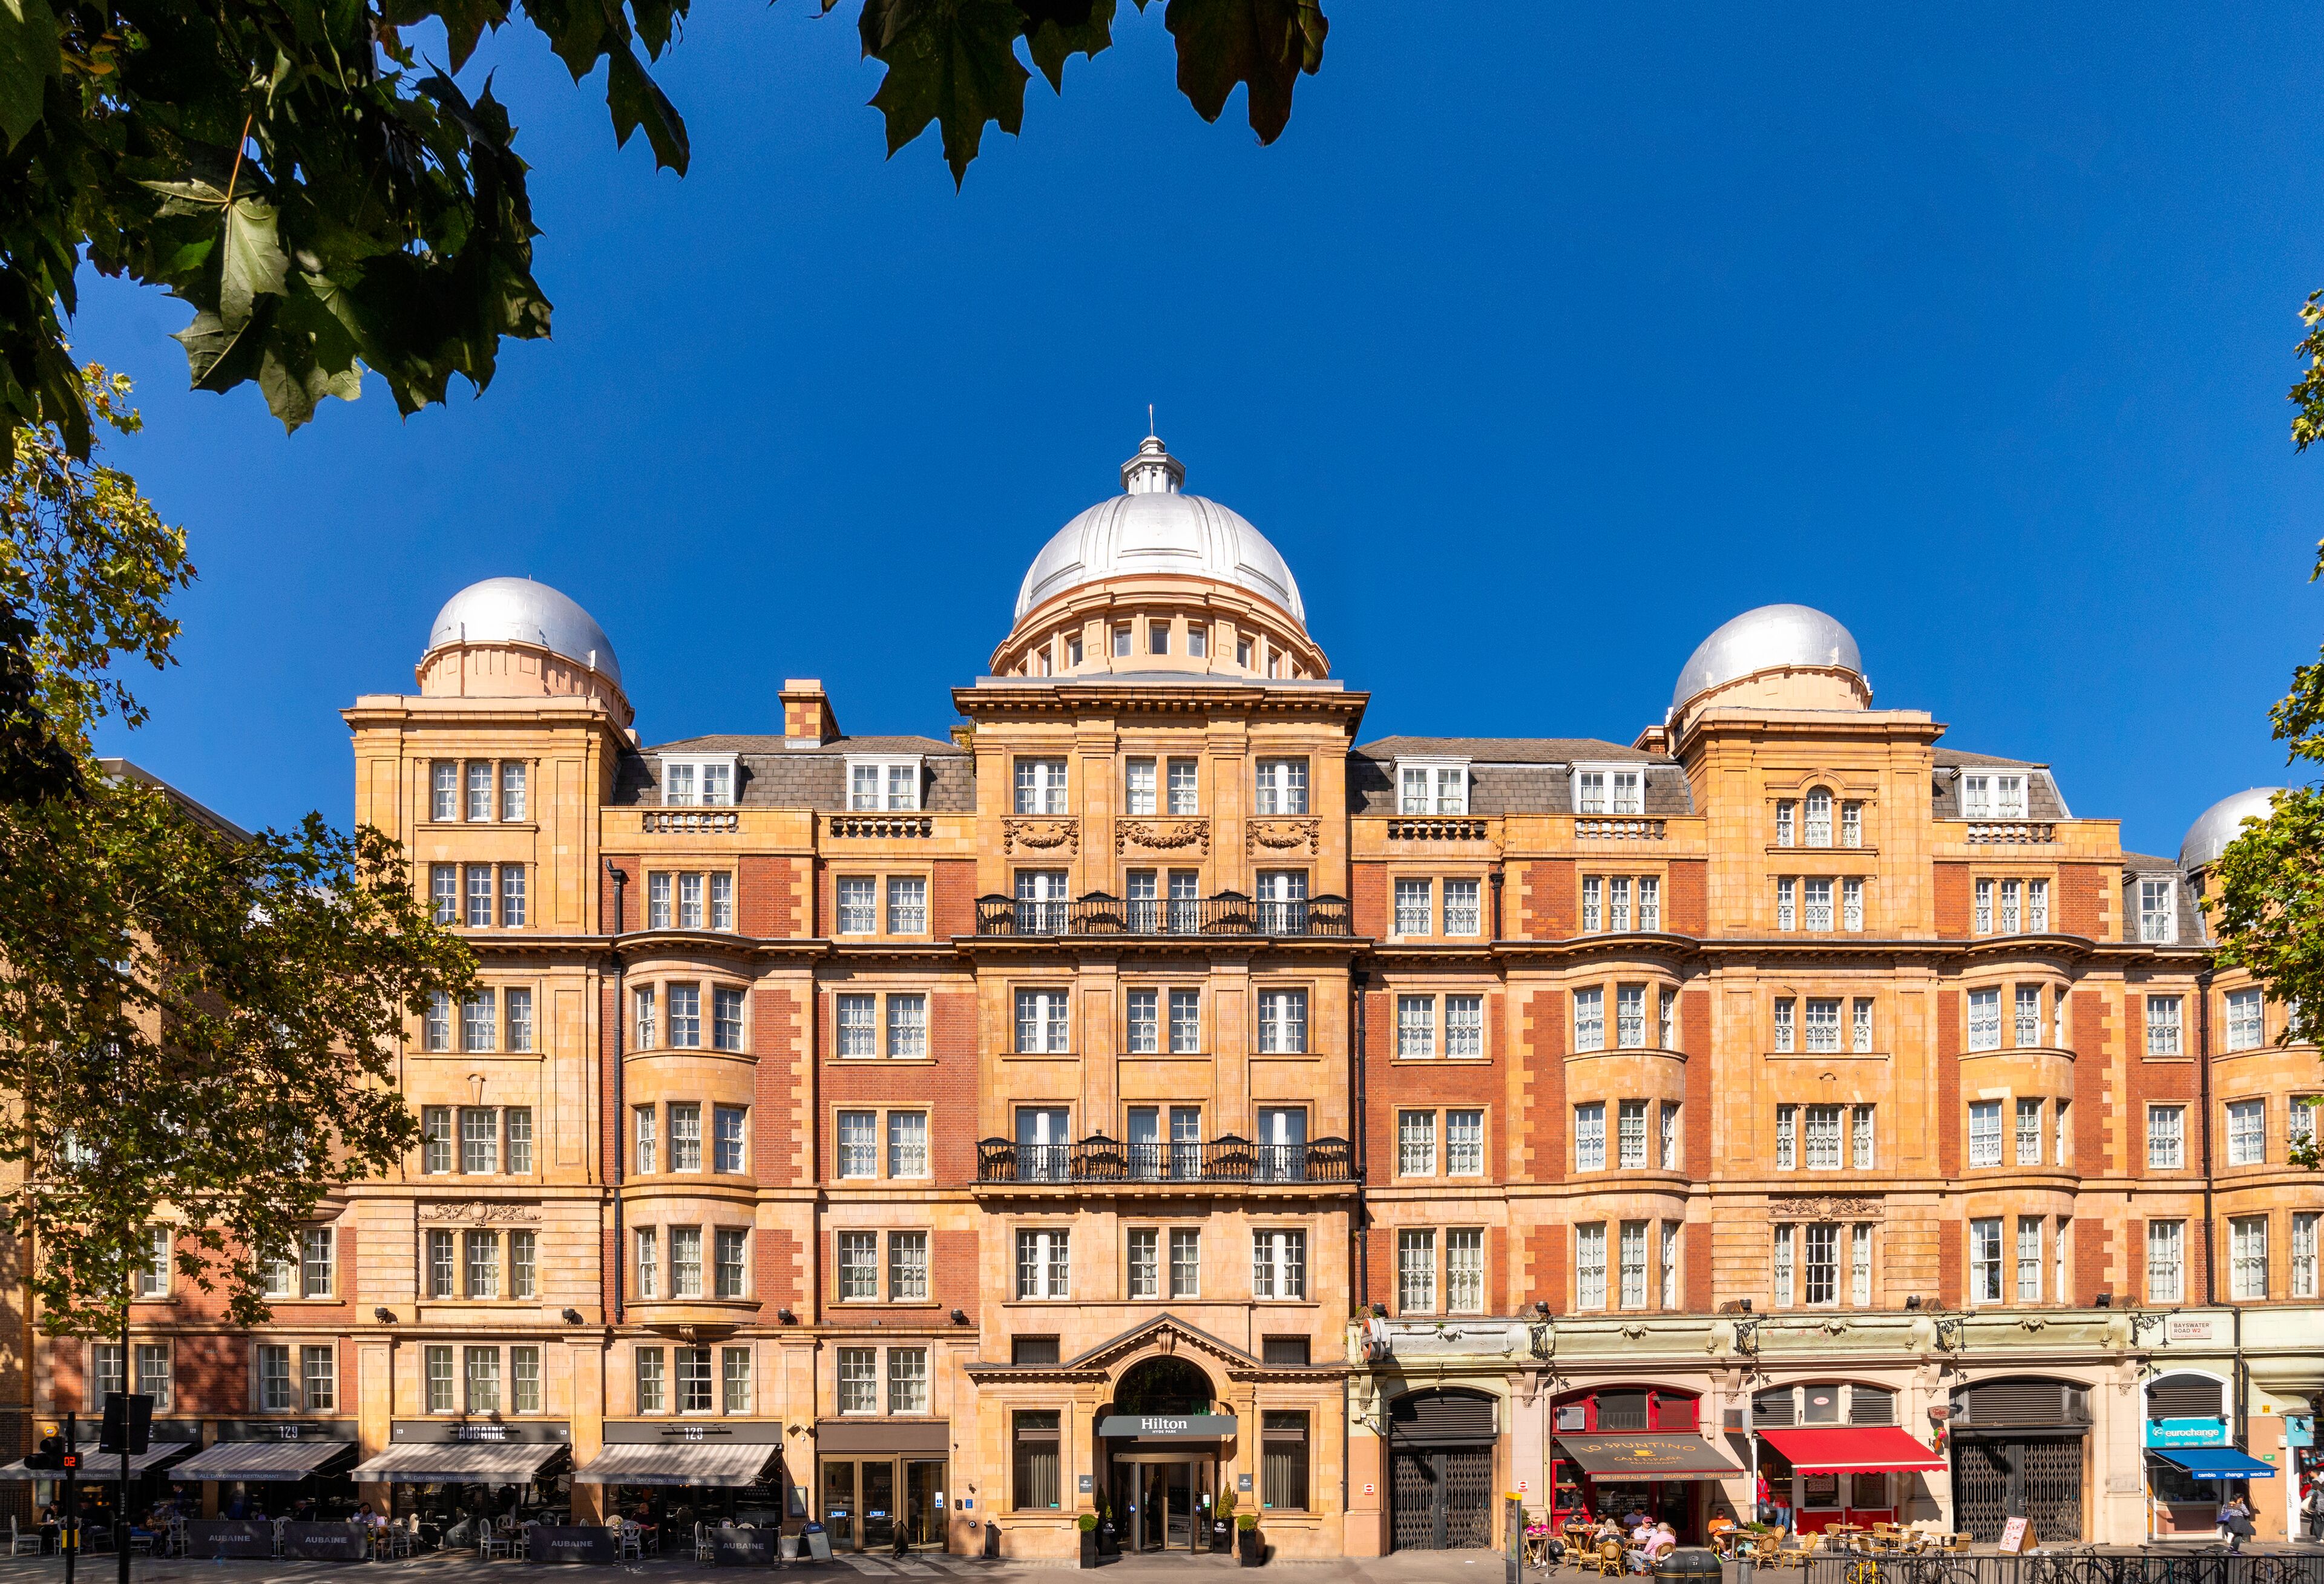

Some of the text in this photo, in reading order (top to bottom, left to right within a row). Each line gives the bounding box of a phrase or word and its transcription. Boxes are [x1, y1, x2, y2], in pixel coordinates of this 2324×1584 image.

[1141, 1418, 1187, 1429] Hilton
[279, 1425, 298, 1438] 129
[459, 1426, 506, 1439] AUBAINE
[684, 1427, 703, 1440] 129
[2165, 1428, 2219, 1437] eurochange
[1604, 1442, 1696, 1451] SPUNTINO
[64, 1456, 76, 1467] 02
